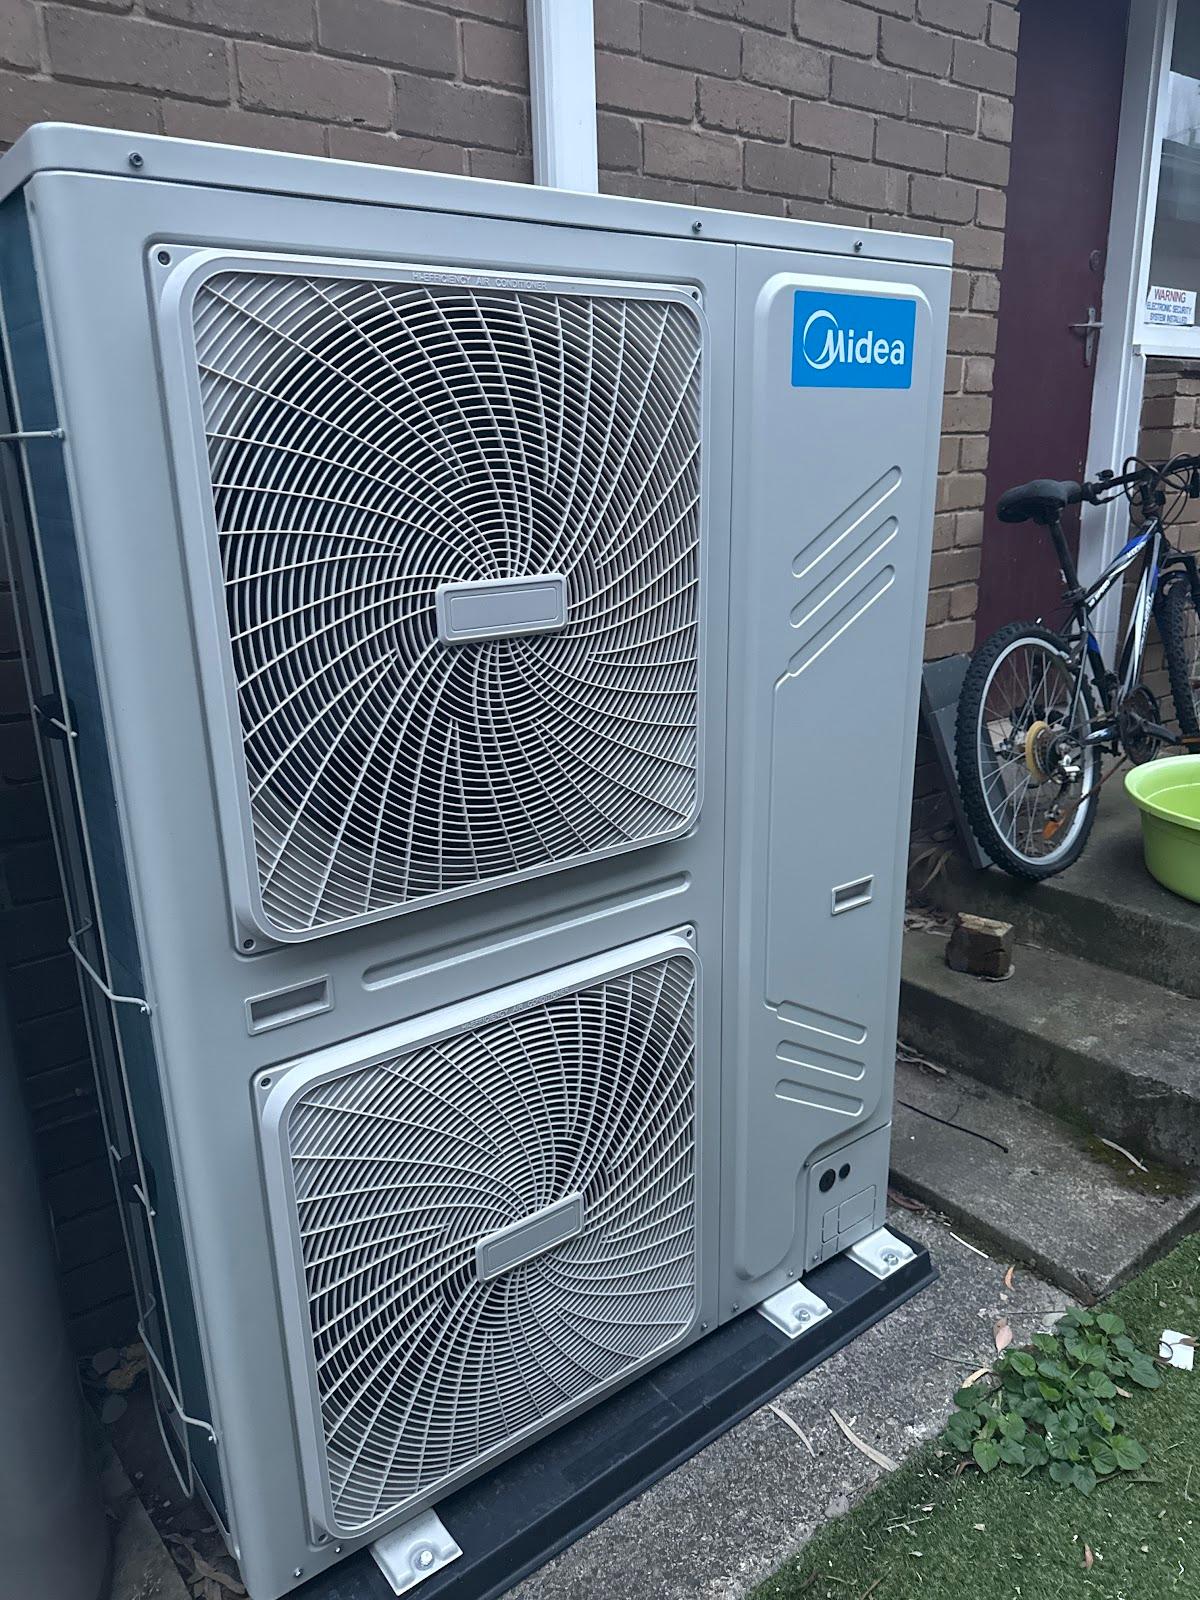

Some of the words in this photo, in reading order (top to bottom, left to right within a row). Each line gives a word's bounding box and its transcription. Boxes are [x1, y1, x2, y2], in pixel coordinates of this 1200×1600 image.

[412, 271, 471, 285] HI-EFFICIENCY
[476, 277, 489, 286] AIR
[496, 278, 548, 290] CONDITIONER
[1154, 288, 1186, 303] WARNING
[803, 309, 905, 369] Midea
